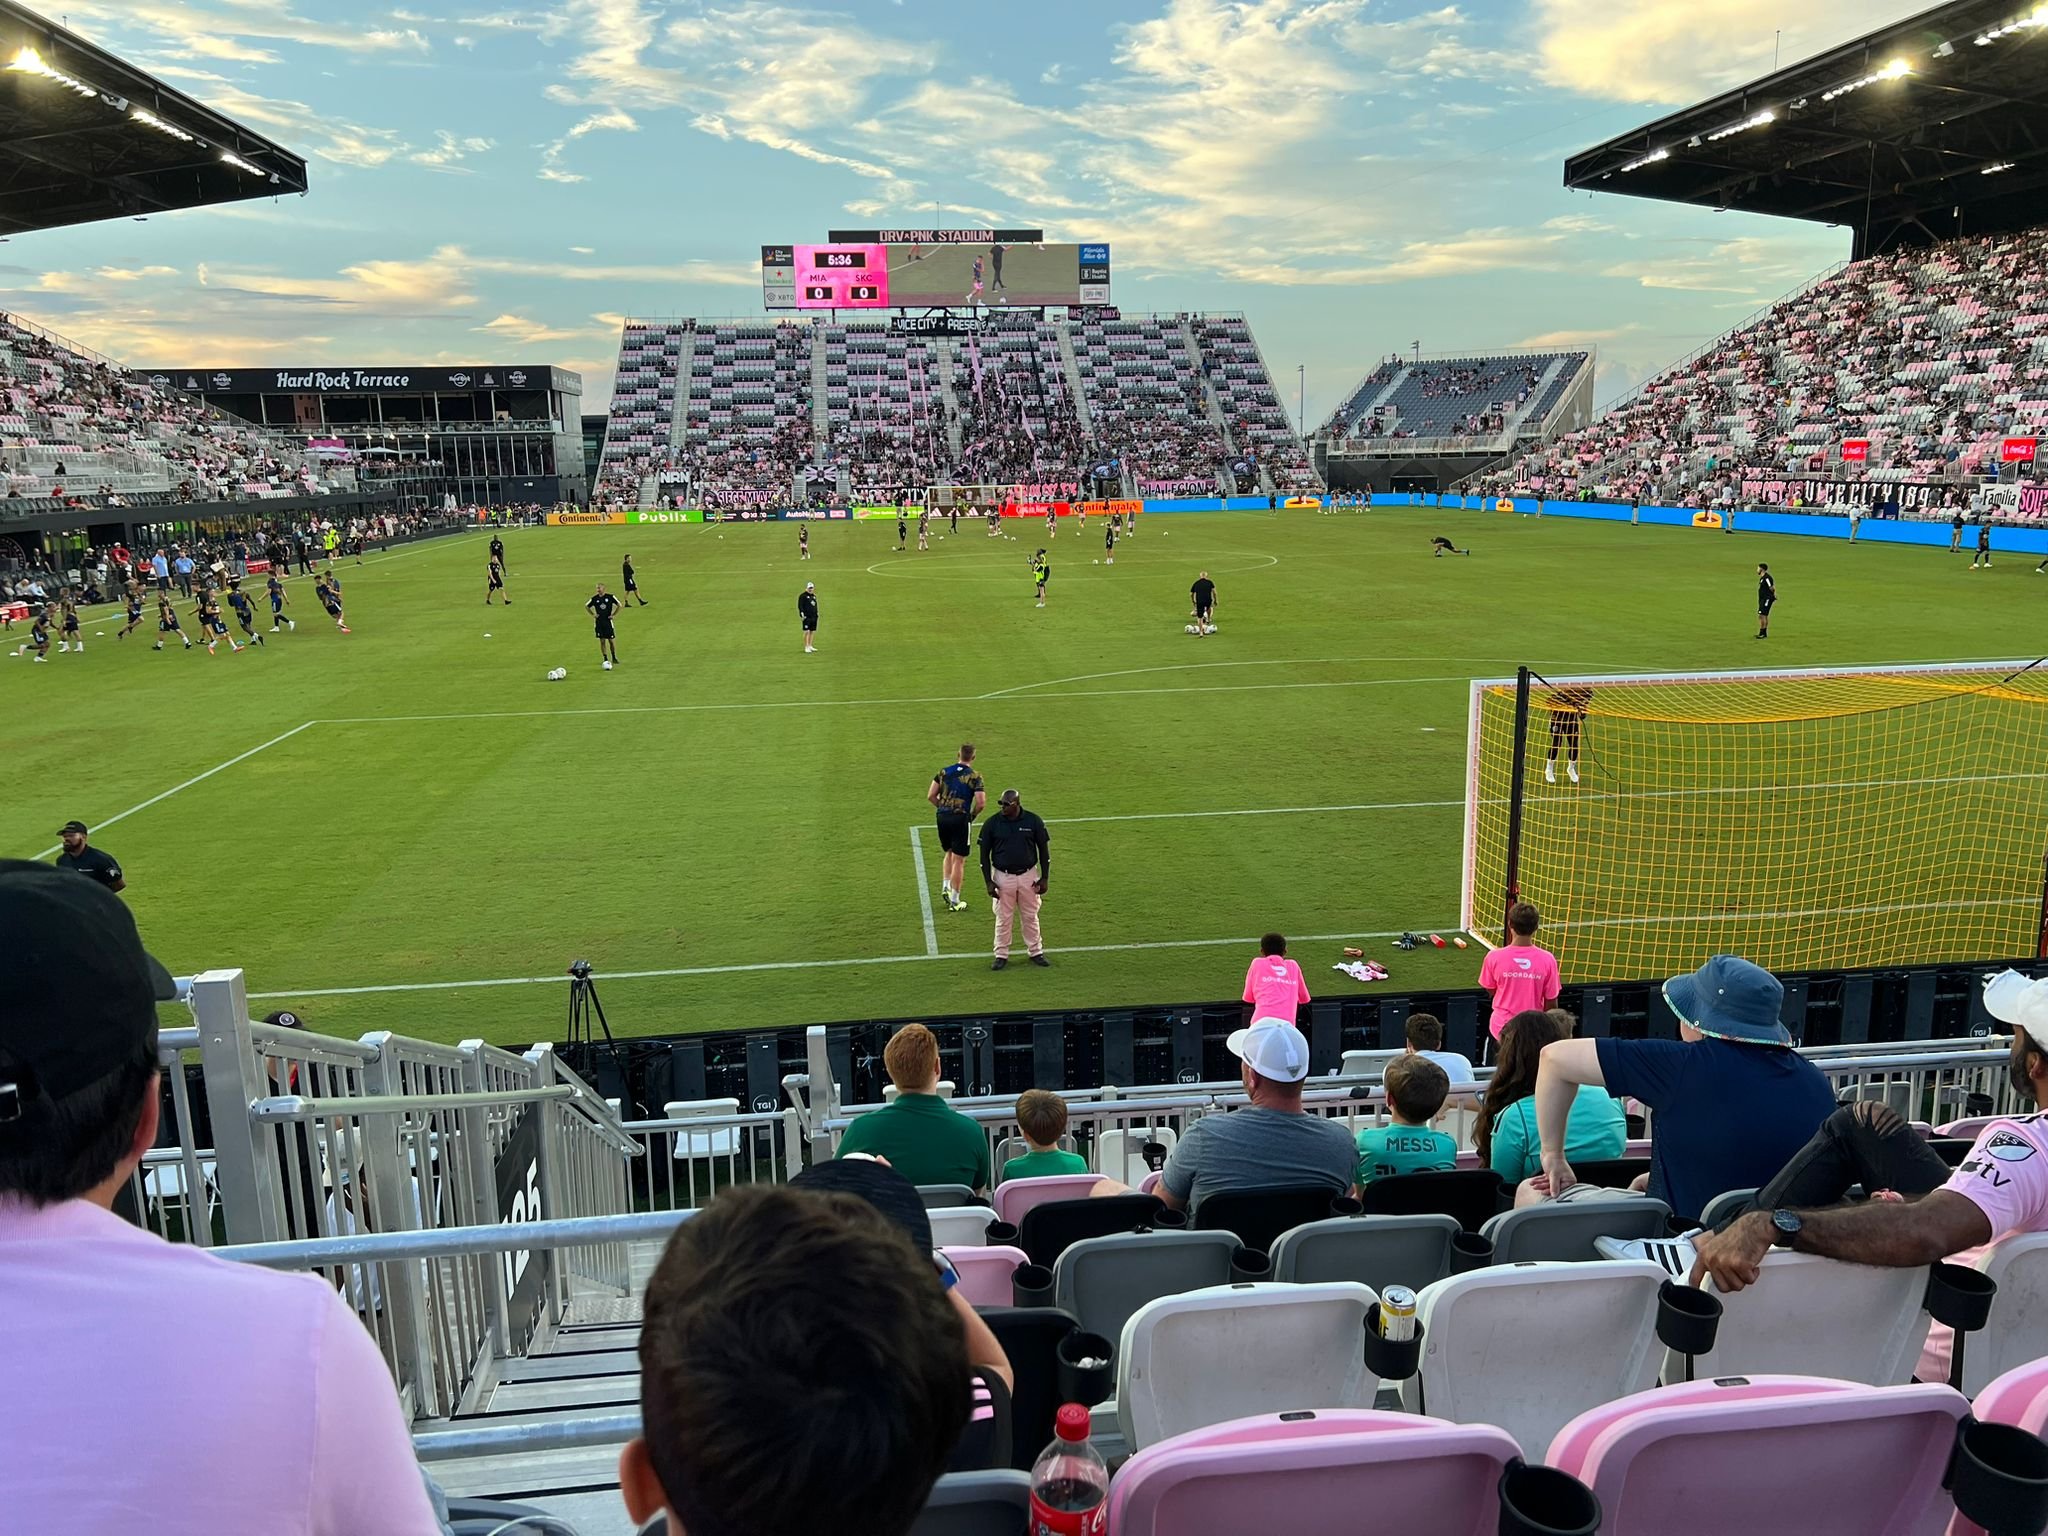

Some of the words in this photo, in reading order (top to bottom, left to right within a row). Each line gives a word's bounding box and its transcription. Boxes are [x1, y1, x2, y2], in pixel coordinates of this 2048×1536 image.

[938, 230, 994, 242] STADIUM
[828, 254, 852, 266] 5:36
[814, 288, 824, 298] 0
[860, 288, 868, 298] 0
[897, 319, 916, 330] VICE
[917, 318, 937, 330] CITY
[276, 372, 314, 388] Hard
[314, 372, 351, 390] Rock
[353, 371, 410, 387] Terrace
[1849, 482, 1893, 504] CITY
[1982, 488, 2016, 507] Familia
[639, 512, 687, 523] Publix
[1386, 1137, 1438, 1152] MESSI
[1997, 1133, 2018, 1145] MLS
[1980, 1162, 2012, 1188] tv
